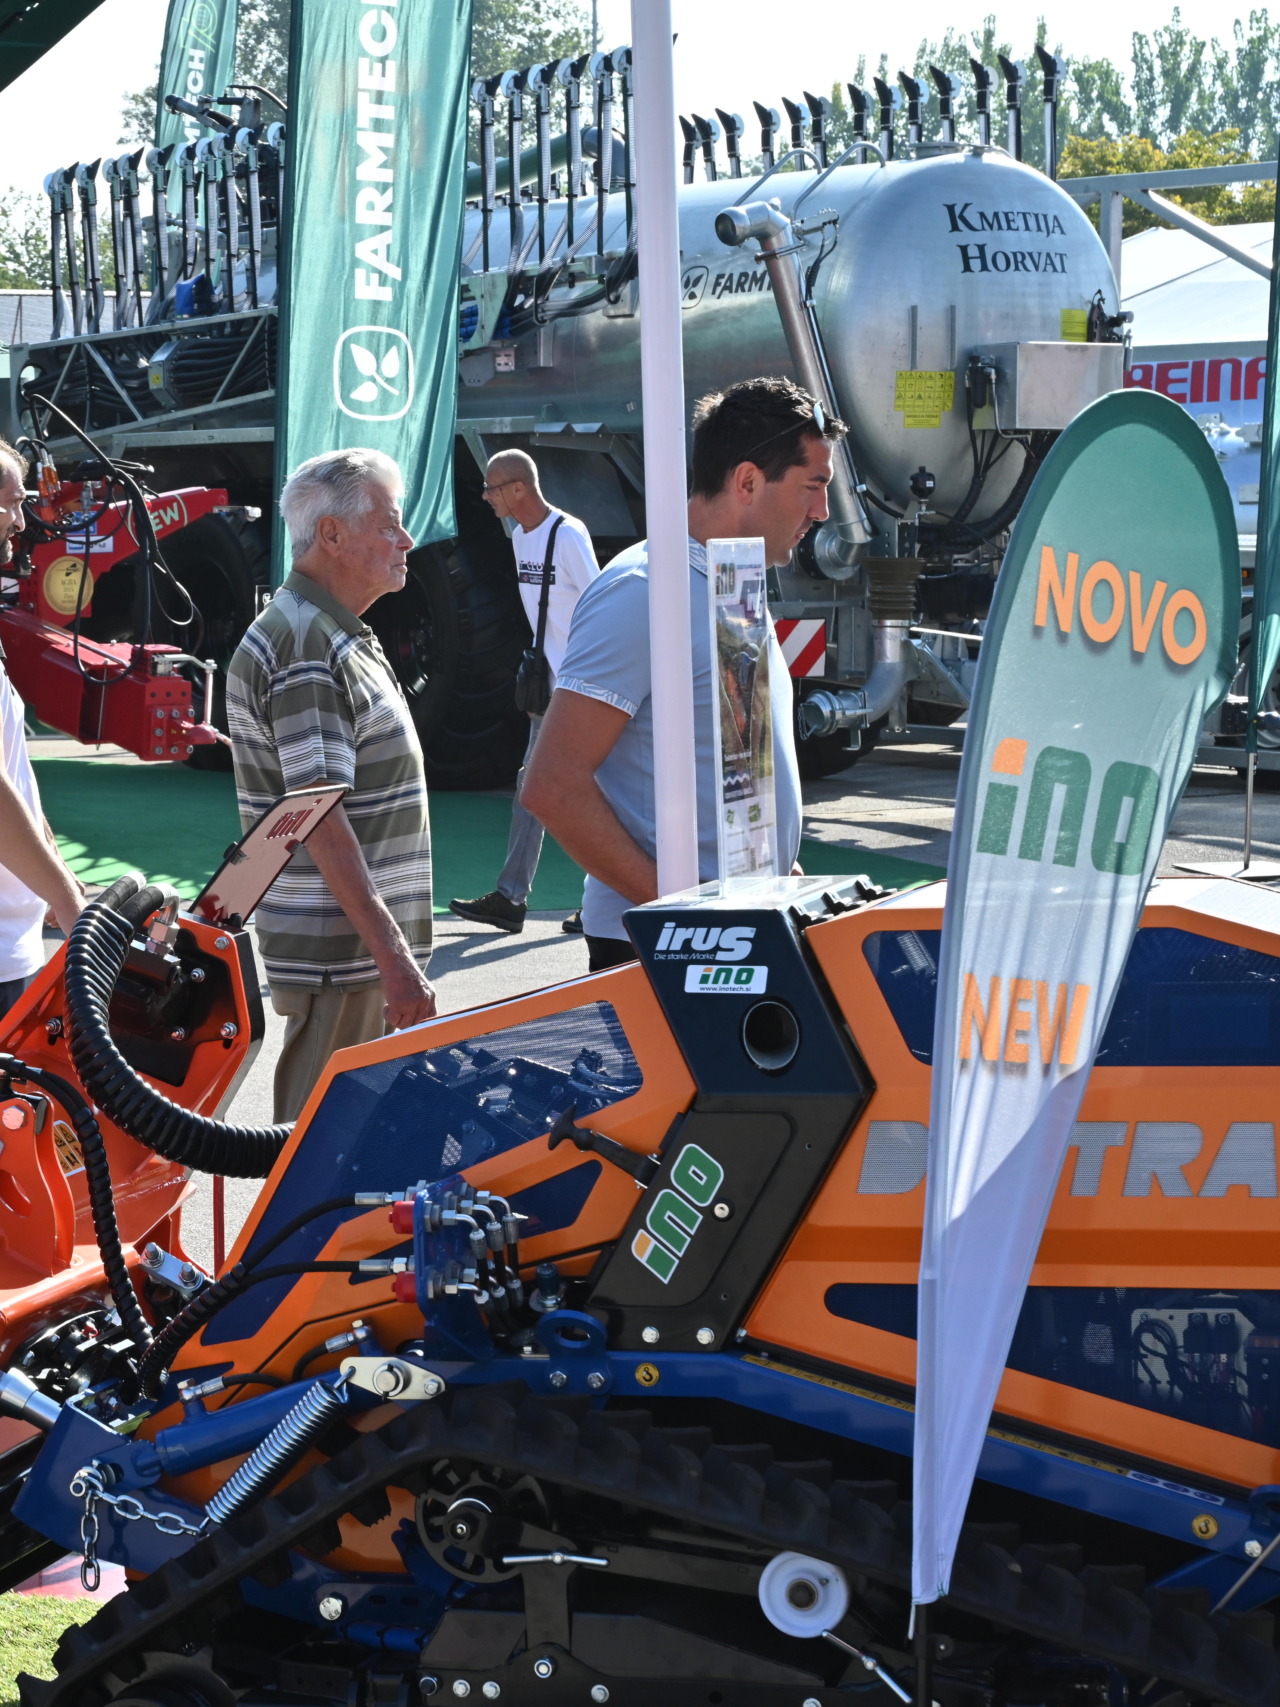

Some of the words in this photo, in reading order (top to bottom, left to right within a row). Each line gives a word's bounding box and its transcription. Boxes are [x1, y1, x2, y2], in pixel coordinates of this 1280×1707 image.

[354, 0, 402, 302] FARMTEC
[942, 202, 1067, 238] KMETIJA
[956, 243, 1068, 274] HORVAT
[1034, 545, 1207, 665] NOVO
[976, 737, 1161, 876] ino
[655, 922, 756, 961] irus
[699, 967, 755, 985] ino
[959, 973, 1091, 1065] NEW
[631, 1143, 724, 1284] ino
